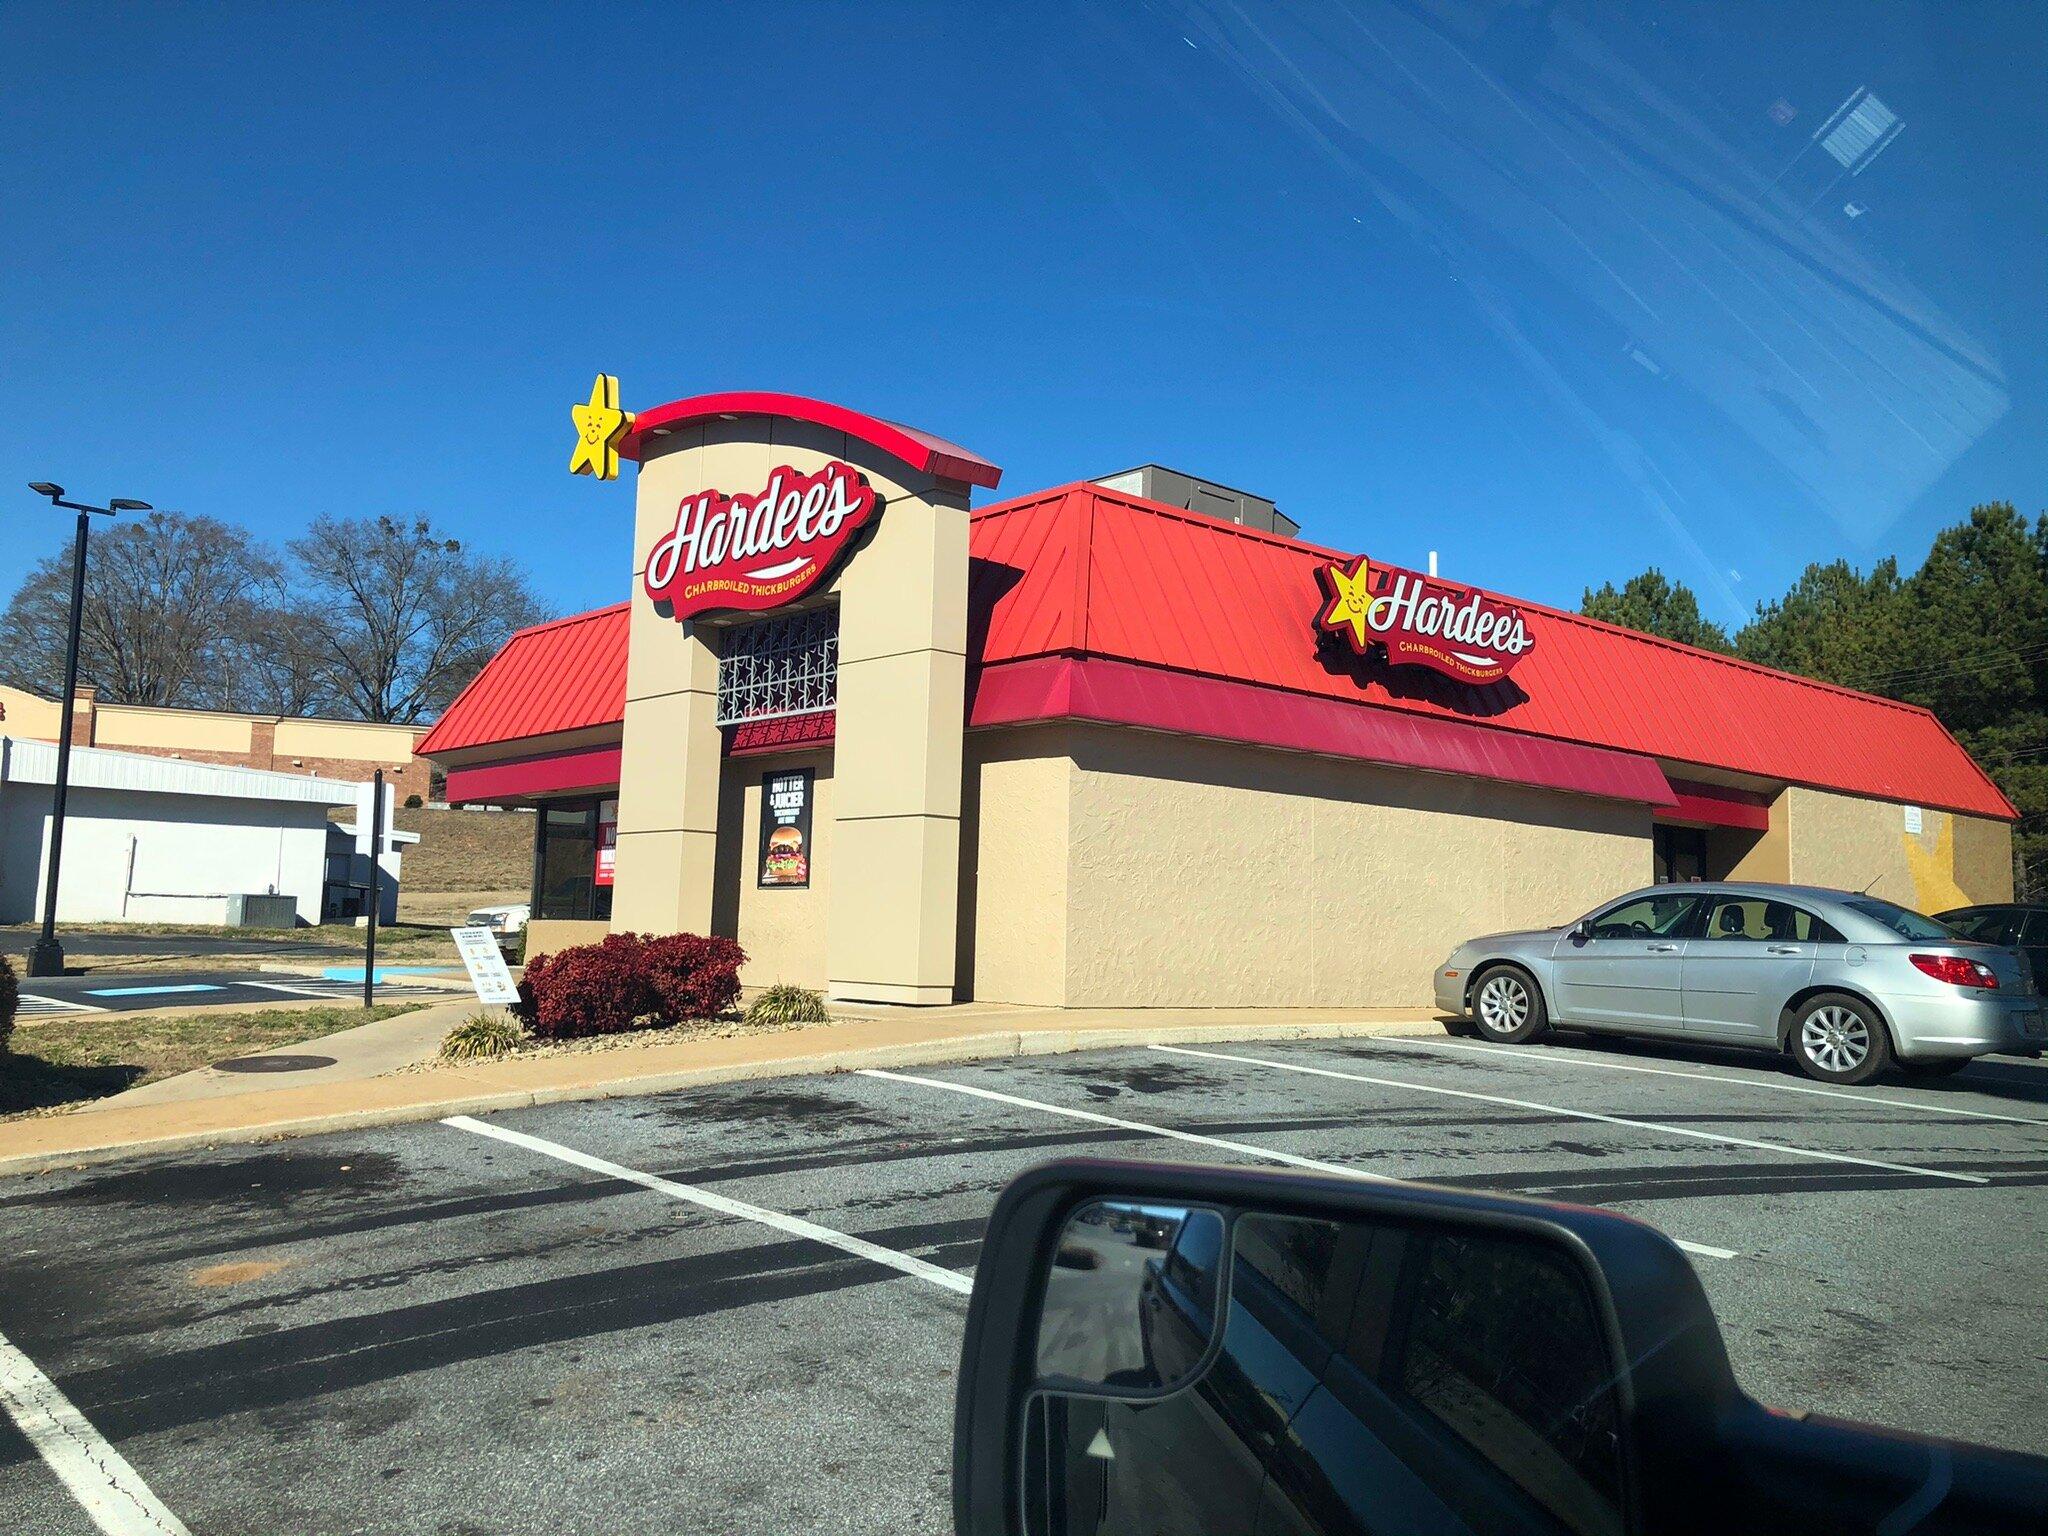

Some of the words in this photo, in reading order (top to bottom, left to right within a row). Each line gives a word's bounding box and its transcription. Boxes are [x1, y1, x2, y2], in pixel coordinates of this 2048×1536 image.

[647, 466, 862, 589] Hardee's
[684, 578, 749, 599] CHARBROILED
[750, 562, 817, 596] THICKBURGERS
[1367, 575, 1533, 654] Hardee's
[1398, 641, 1455, 666] CHARBROILED
[1455, 661, 1503, 677] THICKBURGERS
